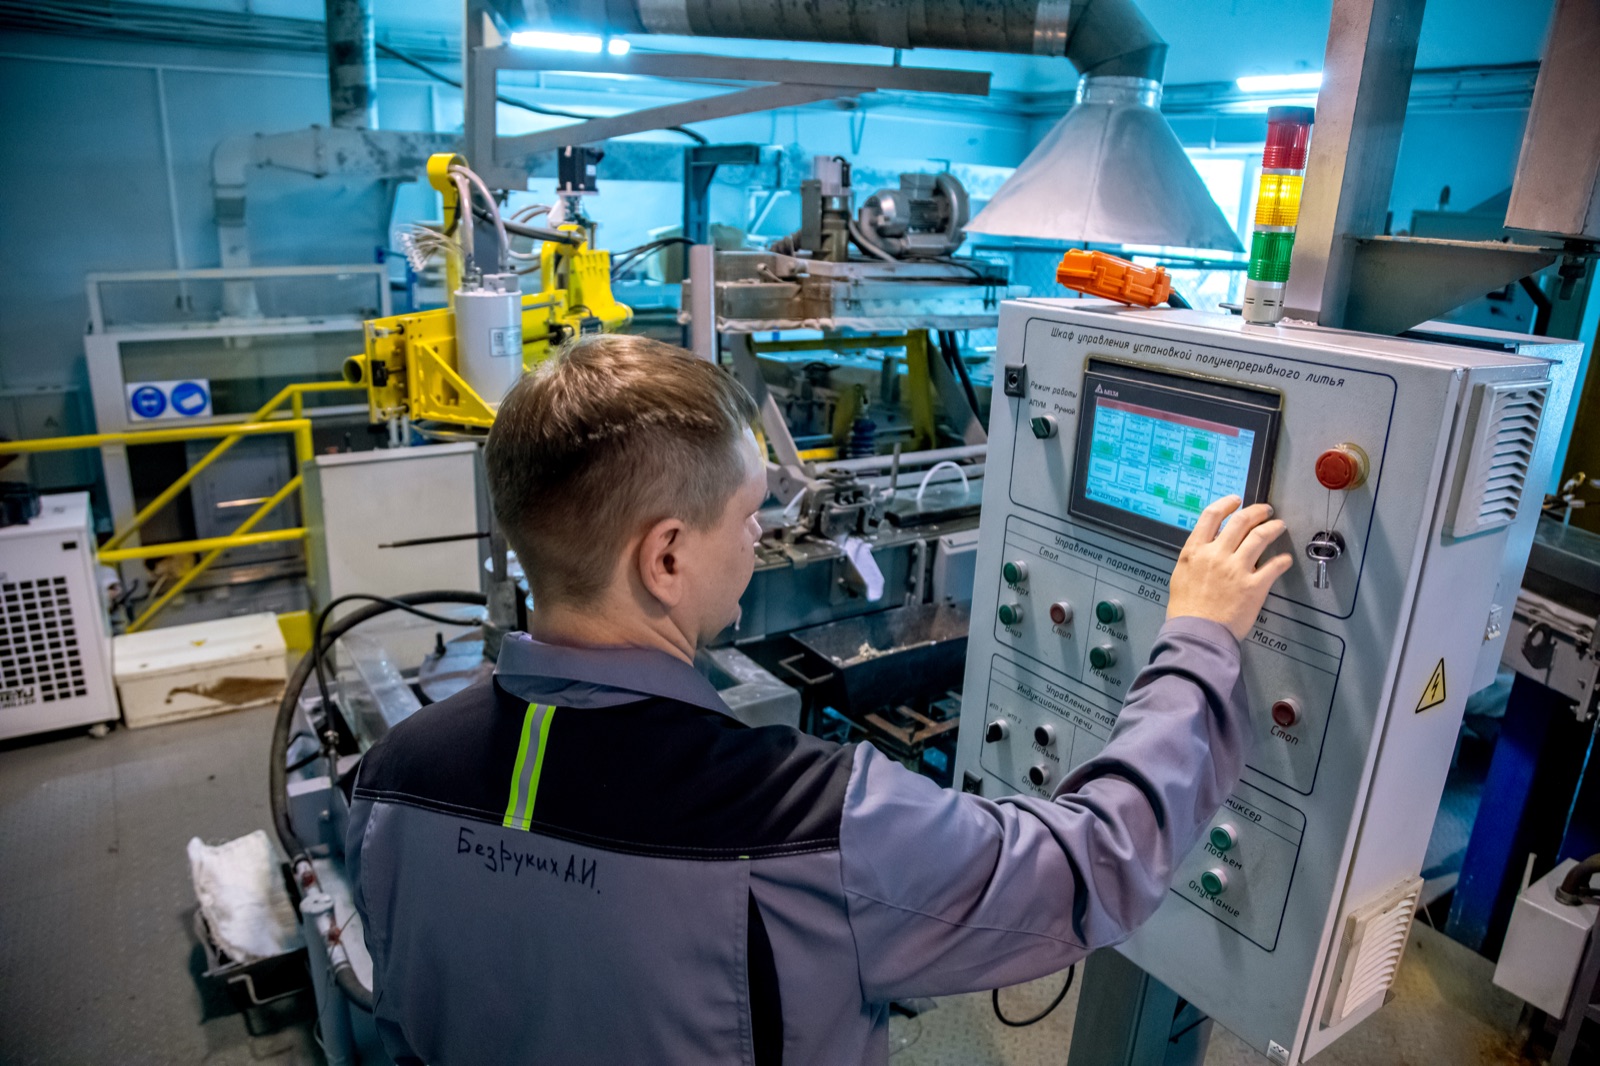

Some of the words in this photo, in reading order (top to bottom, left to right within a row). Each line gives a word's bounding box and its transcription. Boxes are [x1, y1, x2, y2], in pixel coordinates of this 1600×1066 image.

[1051, 327, 1075, 341] Шкаф
[1077, 334, 1130, 350] управления
[1133, 343, 1192, 361] установкой
[1195, 352, 1301, 380] полунепрерывного
[1305, 373, 1345, 387] литья
[1030, 381, 1050, 392] Режим
[1052, 387, 1078, 399] работы
[1029, 399, 1047, 409] АПУМ
[1054, 404, 1076, 416] Ручной
[1038, 546, 1059, 561] Стол
[1054, 536, 1103, 562] Управление
[1106, 556, 1170, 587] параметрами
[1138, 584, 1161, 602] Вода
[1052, 624, 1072, 640] Стоп
[1096, 621, 1129, 642] Больше
[1253, 630, 1288, 651] Масло
[1089, 664, 1122, 687] Меньше
[1017, 683, 1070, 718] Индукционные
[1073, 714, 1093, 730] печи
[1045, 684, 1092, 714] Управление
[1270, 725, 1299, 746] Стоп
[1031, 741, 1060, 763] Подъем
[1225, 798, 1262, 823] миксер
[457, 826, 559, 877] Безруких
[564, 854, 601, 895] А.И.
[1203, 842, 1243, 870] Подъем
[1188, 880, 1240, 918] Опускание
